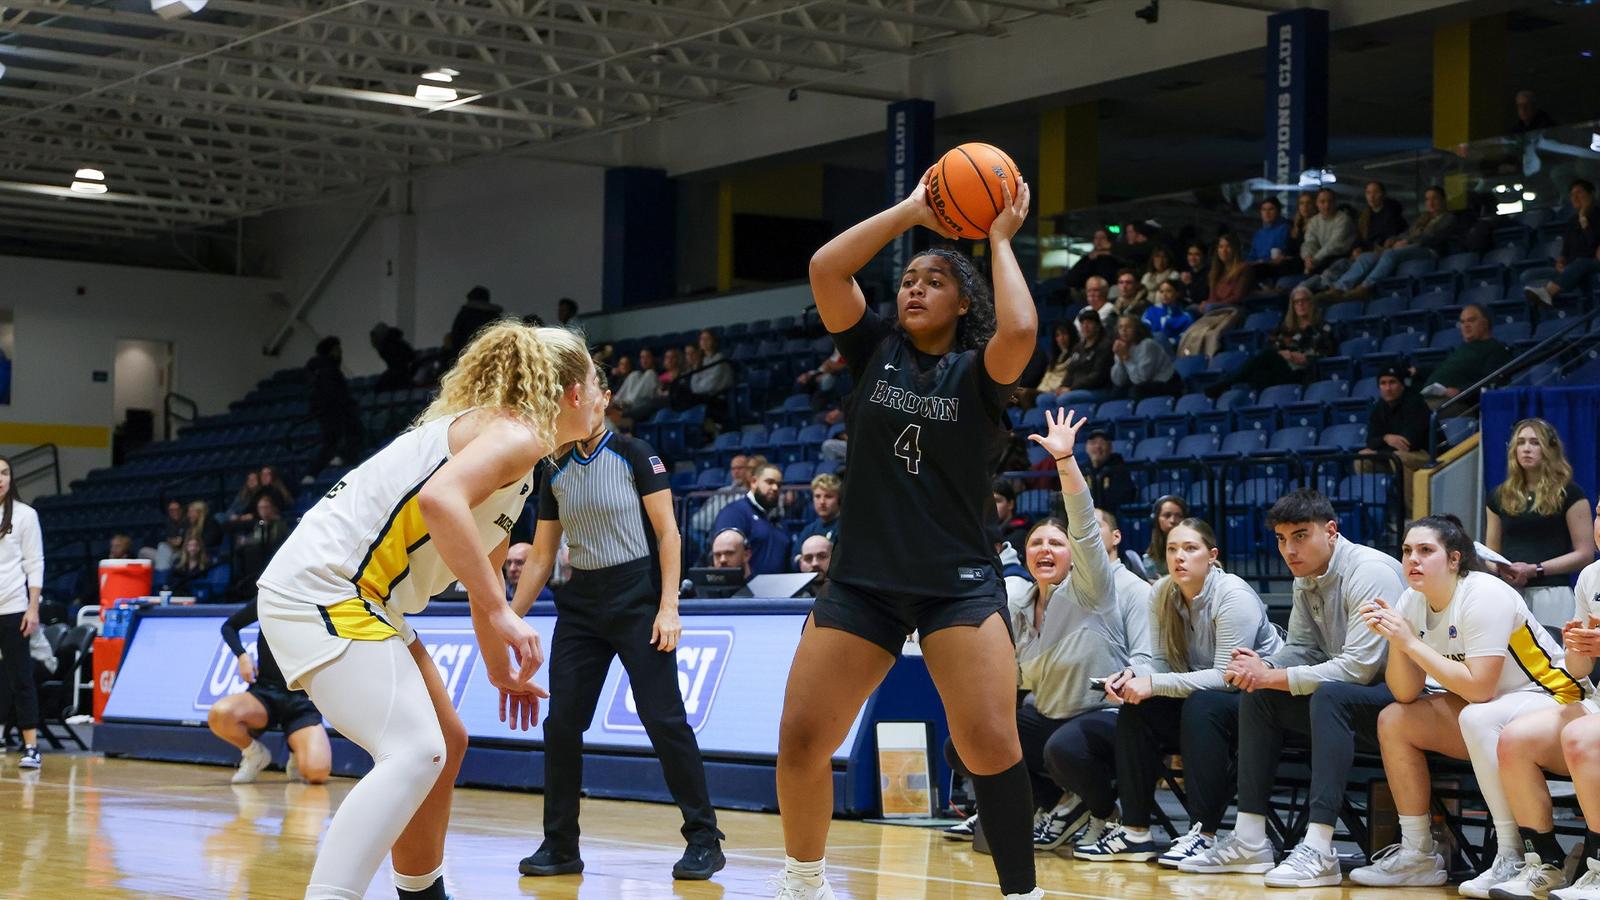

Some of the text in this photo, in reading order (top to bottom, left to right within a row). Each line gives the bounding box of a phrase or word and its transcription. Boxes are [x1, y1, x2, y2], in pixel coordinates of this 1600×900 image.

[1278, 24, 1293, 88] CLUB
[895, 111, 906, 165] CLUB
[930, 172, 963, 232] Wilson
[870, 380, 959, 421] BROWN
[894, 423, 921, 475] 4
